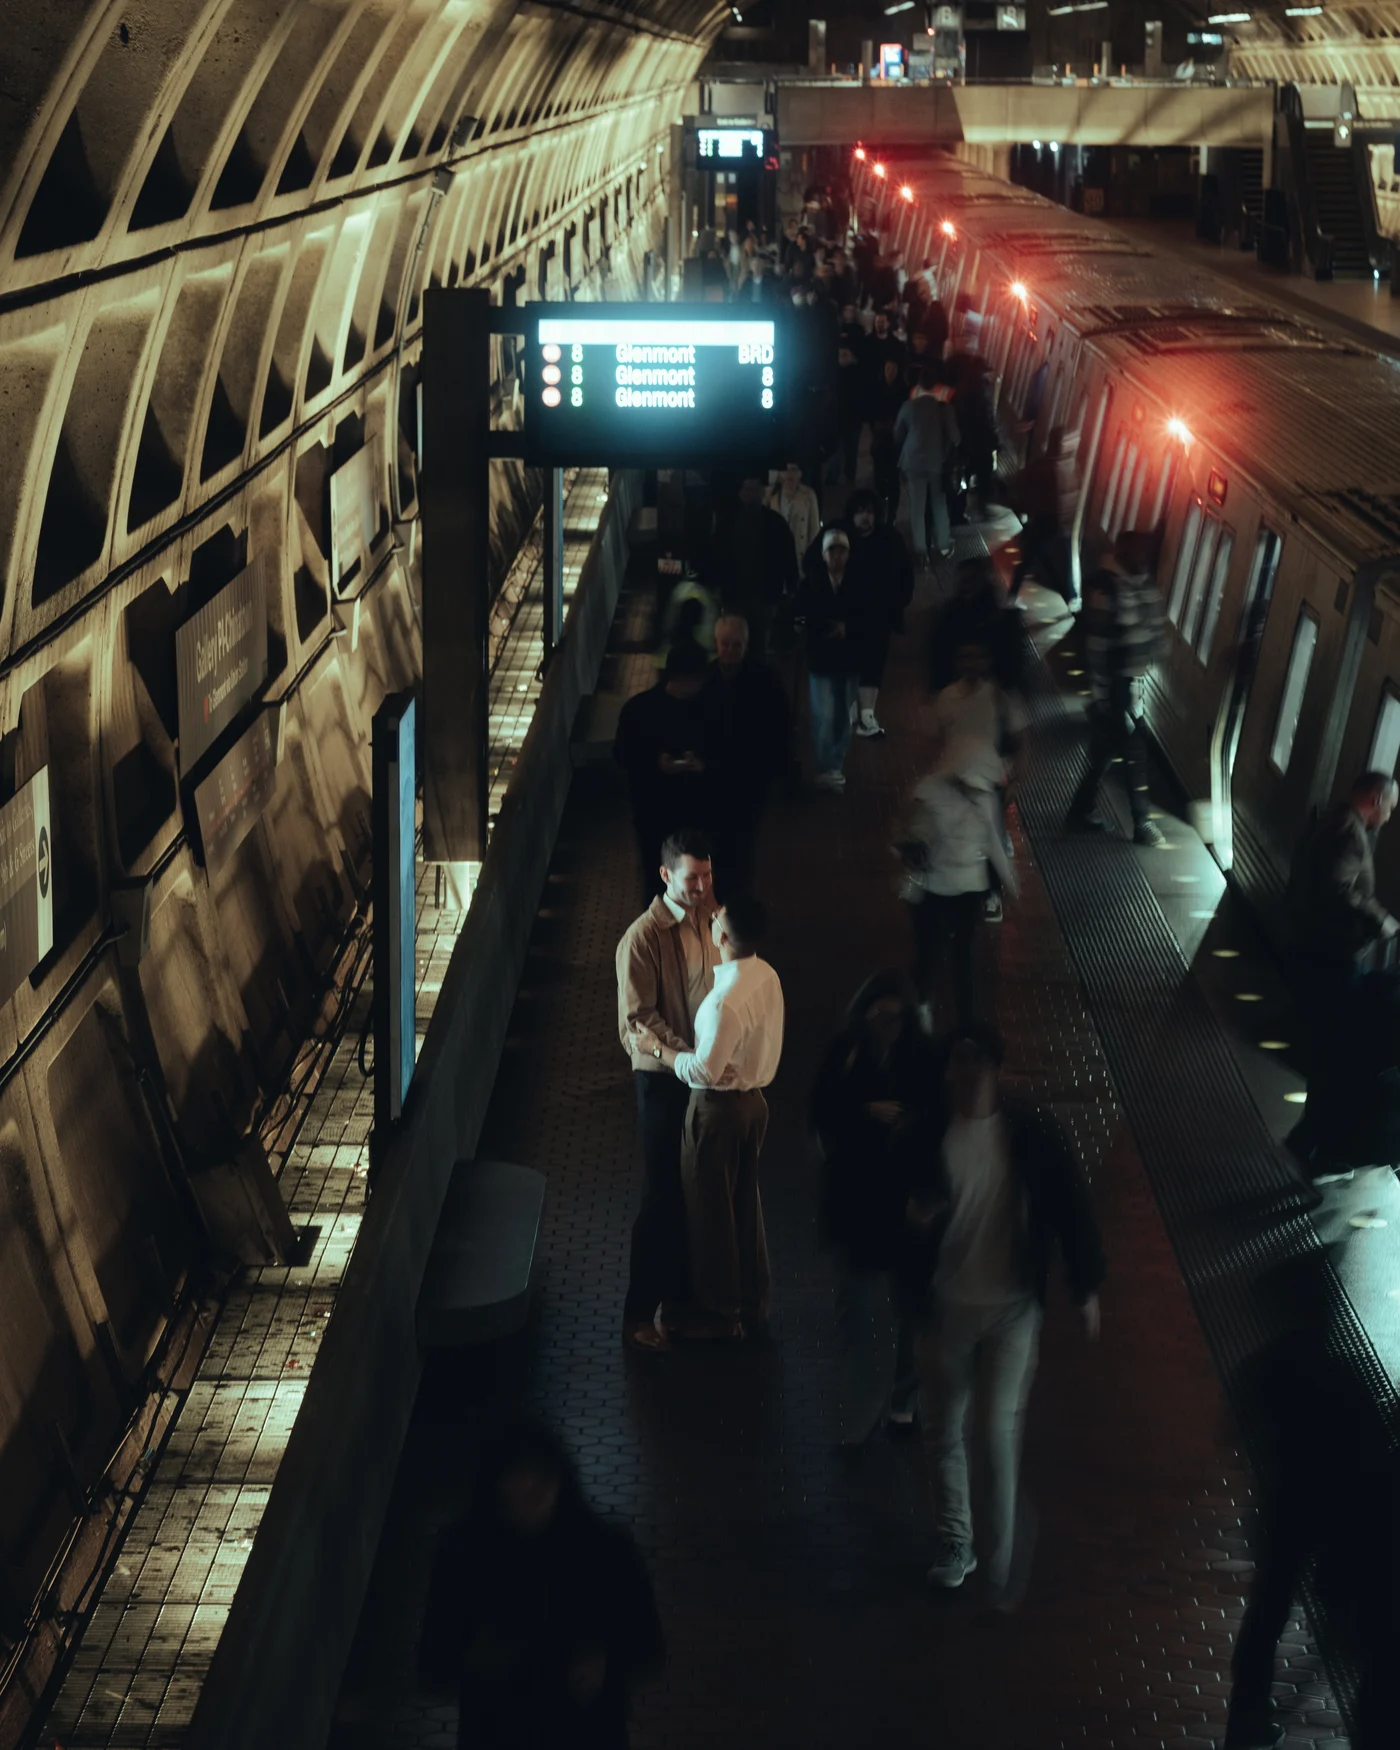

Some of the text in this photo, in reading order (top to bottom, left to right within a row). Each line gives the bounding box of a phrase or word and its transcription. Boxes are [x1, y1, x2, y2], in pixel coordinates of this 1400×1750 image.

[571, 343, 584, 363] 8
[615, 343, 696, 364] Glenmont
[738, 344, 774, 365] BRD
[571, 364, 584, 384] 8
[615, 364, 696, 386] Glenmont
[762, 367, 774, 387] 8
[571, 386, 583, 407] 8
[615, 387, 696, 408] Glenmont
[761, 389, 773, 409] 8
[195, 632, 217, 683] Gallery
